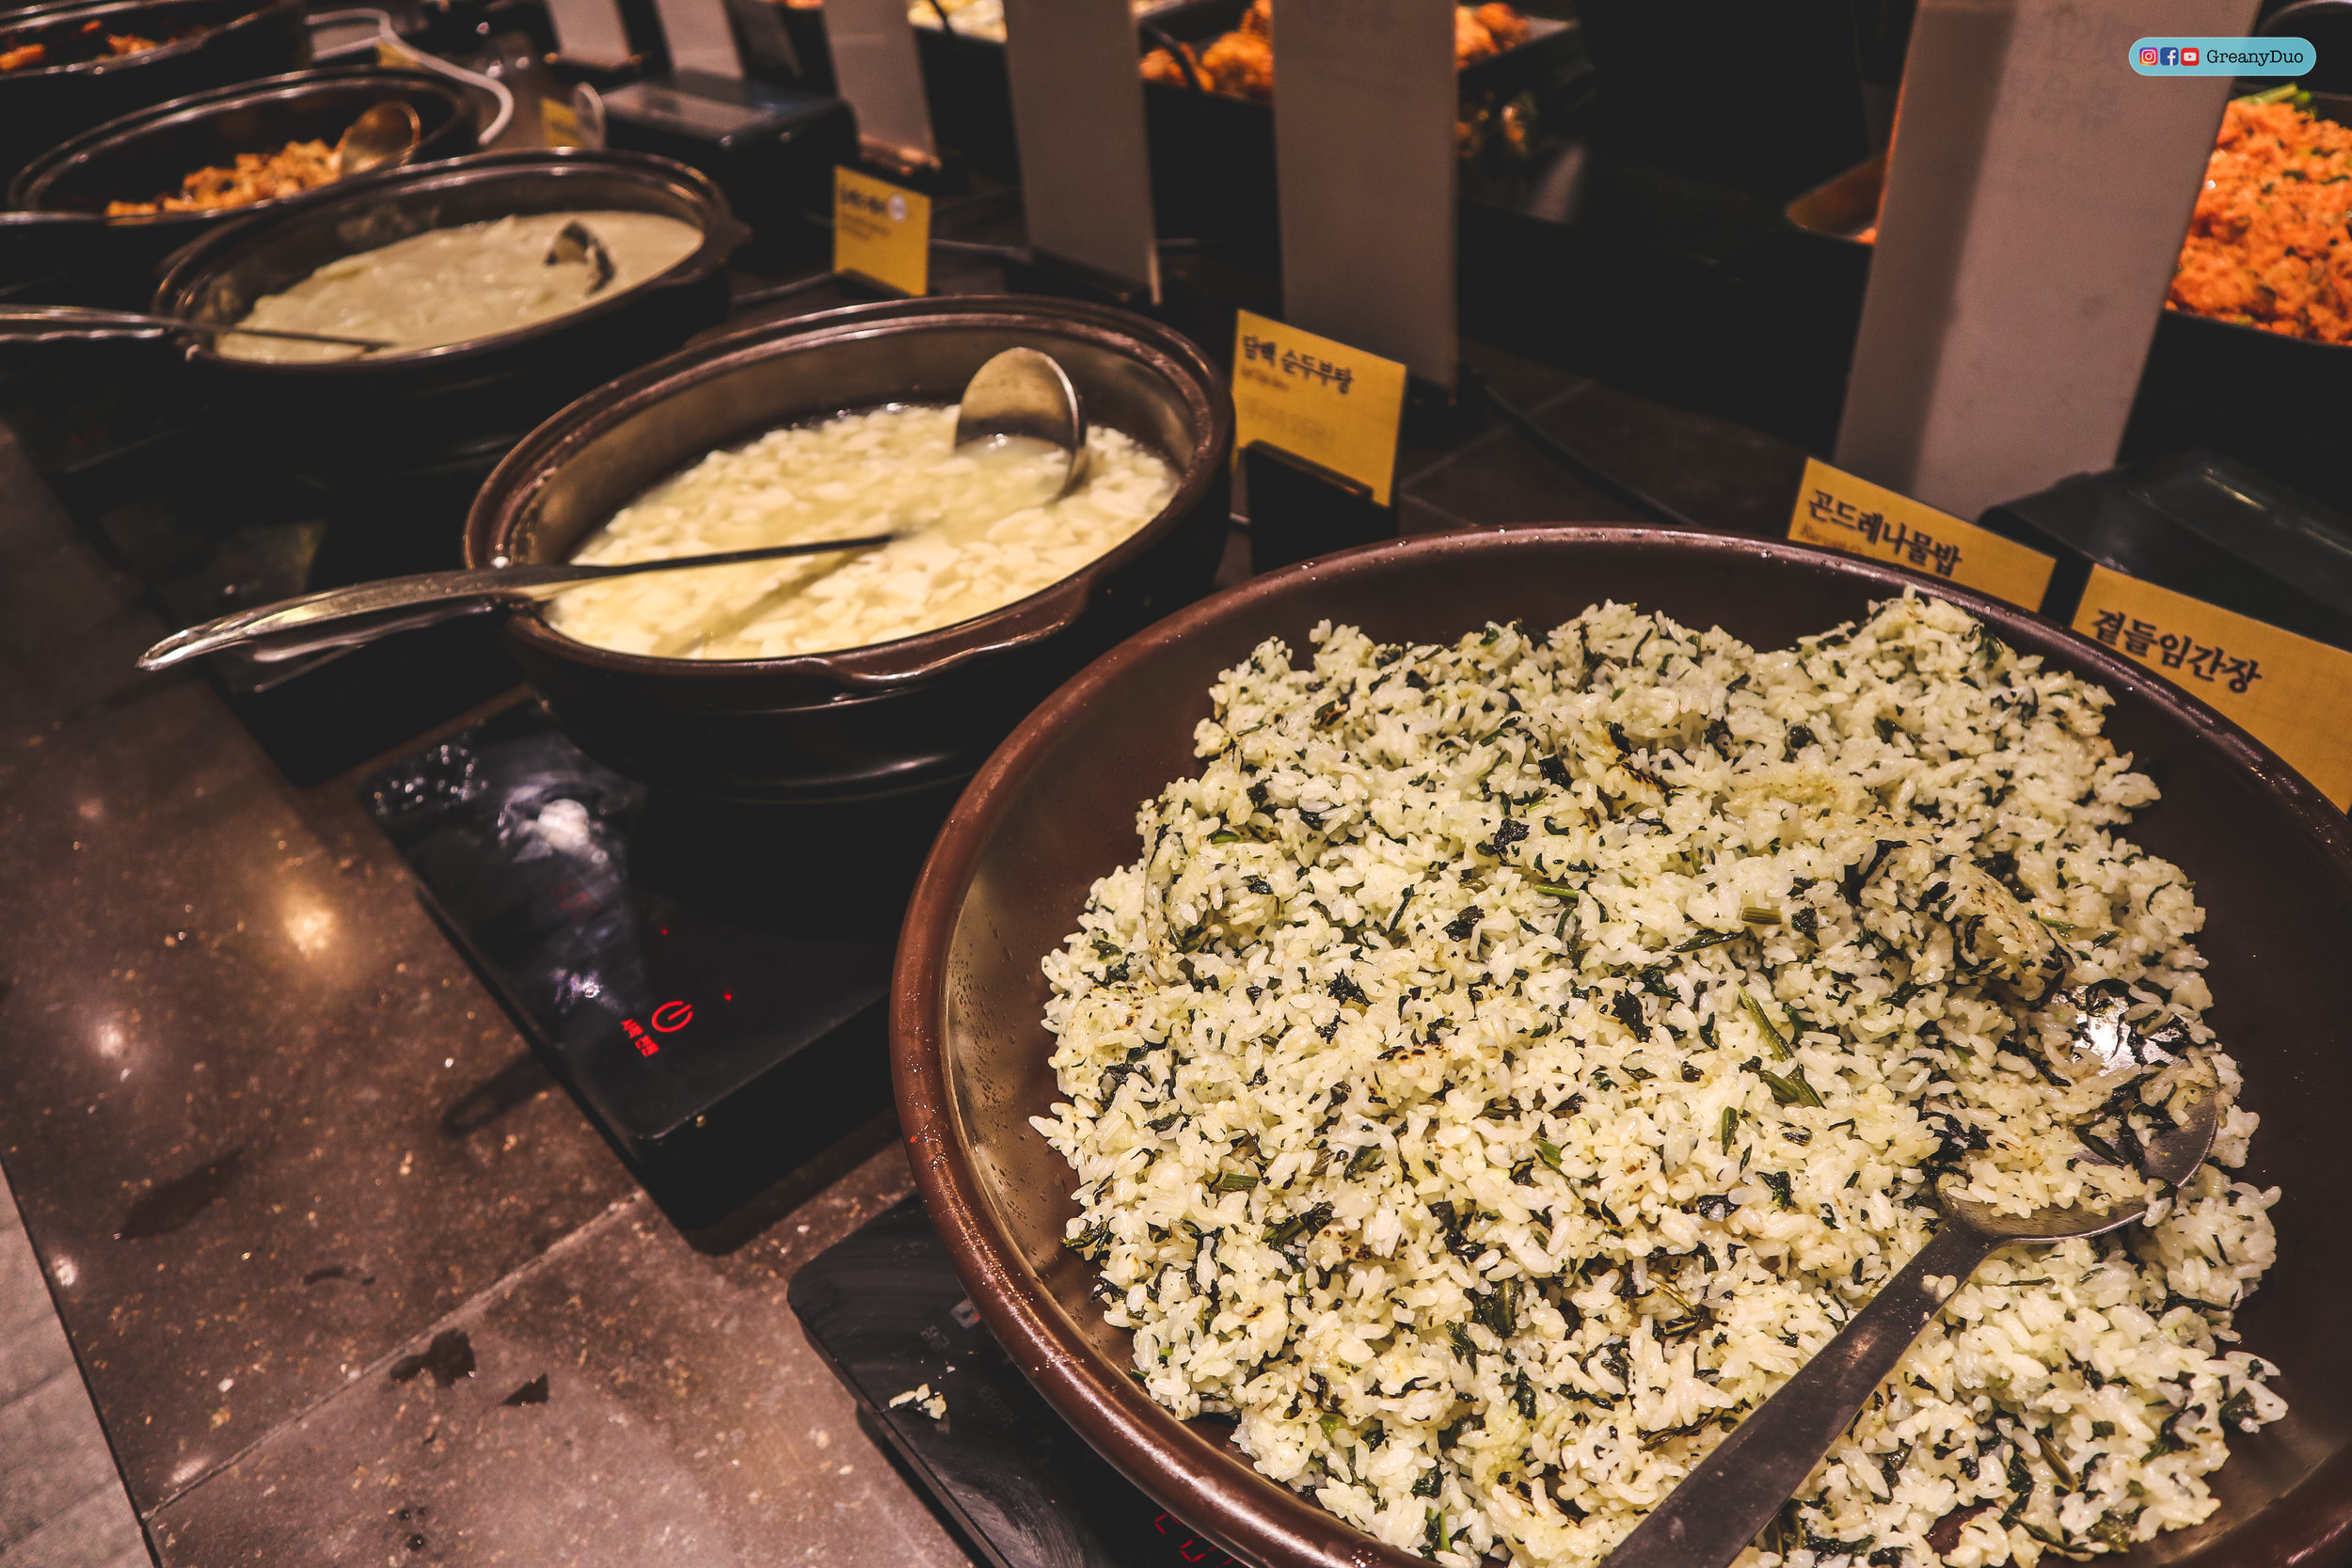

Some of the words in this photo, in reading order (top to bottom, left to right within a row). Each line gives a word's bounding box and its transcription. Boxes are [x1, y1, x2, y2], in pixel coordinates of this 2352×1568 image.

[1281, 349, 1353, 394] 순두부탕
[1808, 489, 1963, 577] 곤드레나물밥
[2090, 609, 2264, 693] 곁들임간장
